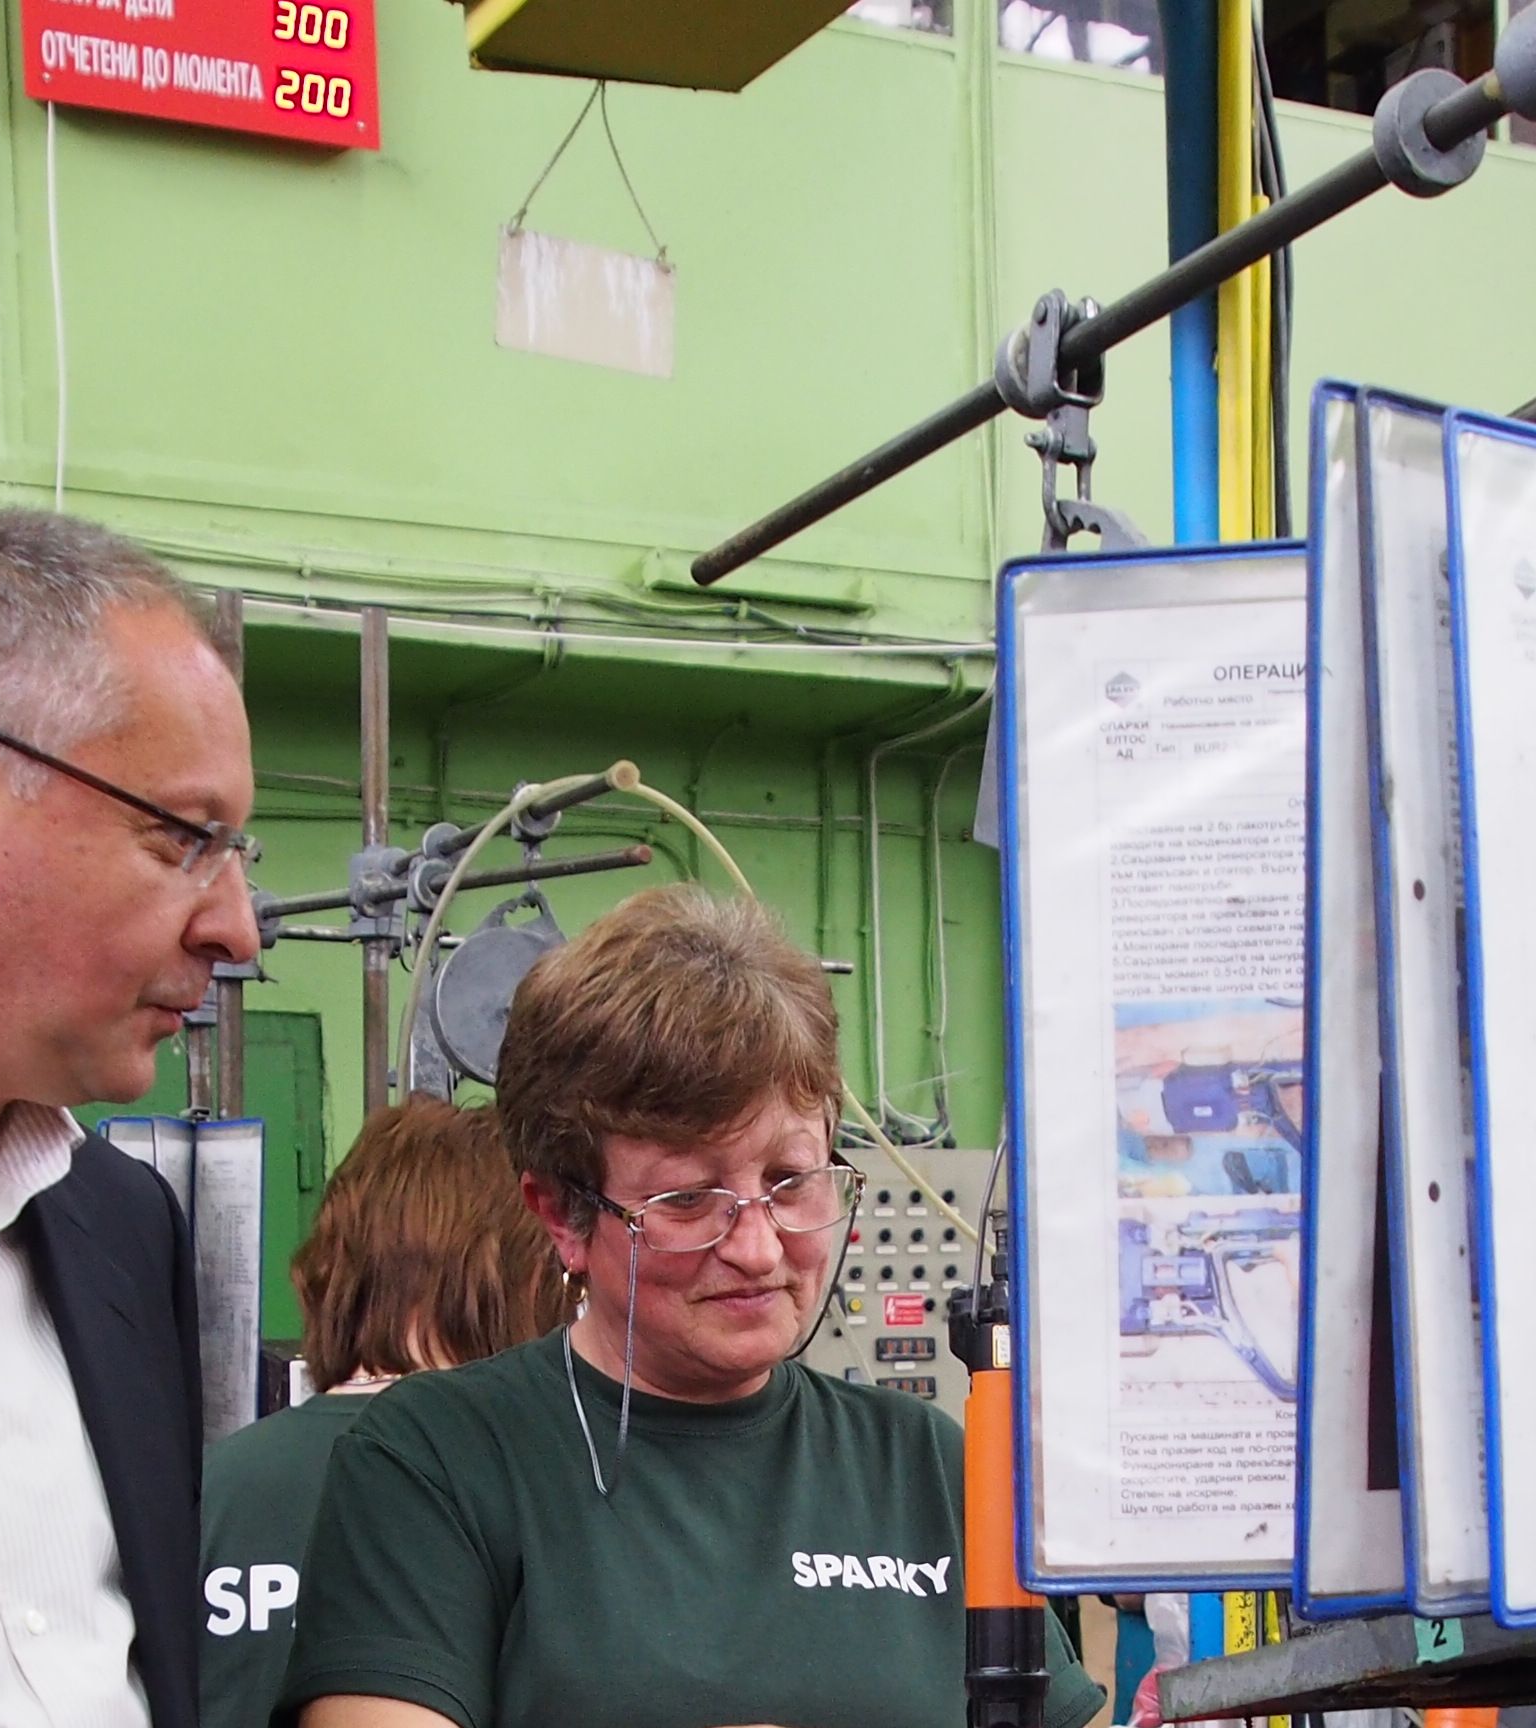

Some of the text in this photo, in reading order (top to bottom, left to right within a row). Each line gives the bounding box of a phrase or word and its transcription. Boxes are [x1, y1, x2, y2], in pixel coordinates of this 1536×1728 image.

[275, 0, 349, 49] 300
[41, 28, 263, 99] ОТЧЕТЕНИ ДО МОМЕНТА
[274, 69, 352, 118] 200
[1106, 736, 1146, 745] ЕЛТОС
[1116, 749, 1134, 760] АД
[1207, 823, 1213, 832] 2
[1173, 1432, 1187, 1440] на
[1191, 1431, 1251, 1440] машината
[1121, 1504, 1148, 1515] Шум
[791, 1551, 952, 1598] SPARKY
[204, 1563, 299, 1637] SP
[1430, 1618, 1448, 1648] 2
